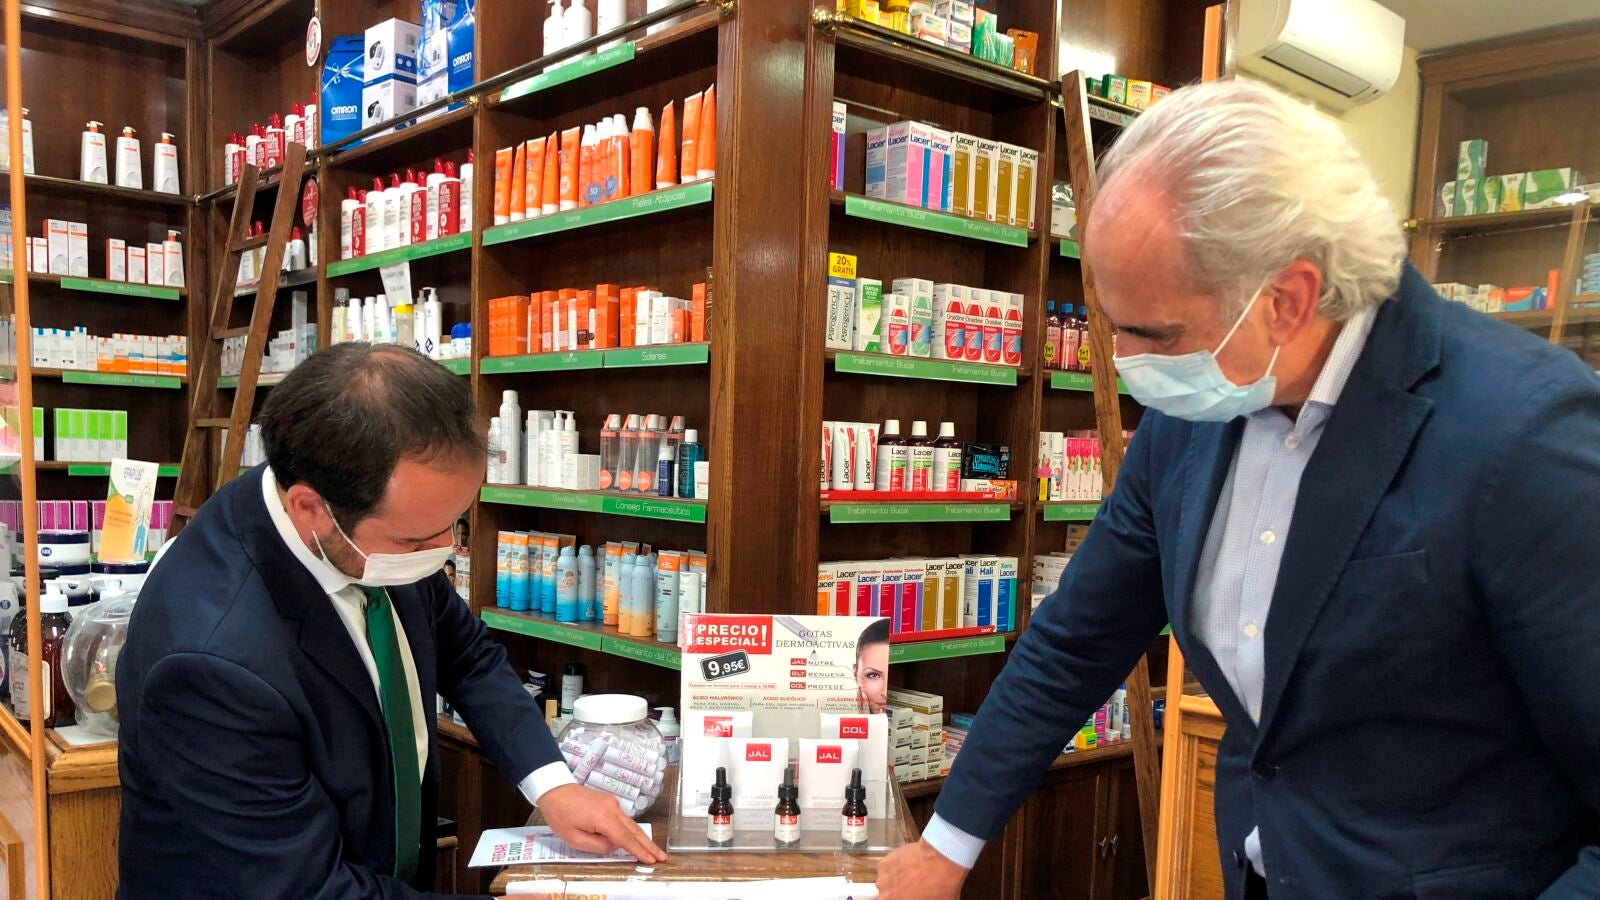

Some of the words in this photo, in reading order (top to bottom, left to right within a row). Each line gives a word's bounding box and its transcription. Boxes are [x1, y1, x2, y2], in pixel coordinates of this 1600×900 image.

[452, 52, 472, 67] OMRON
[331, 105, 357, 114] OMRON
[888, 135, 908, 145] Lacer
[911, 134, 929, 145] Lacer
[956, 135, 975, 146] Lacer
[868, 140, 885, 149] Lacer
[931, 140, 950, 151] Lacer
[977, 140, 994, 151] Lacer
[1000, 145, 1018, 156] Lacer
[1020, 149, 1037, 160] Lacer
[836, 256, 852, 267] 20%
[833, 266, 854, 275] GRATIS
[828, 290, 837, 341] Parogencyl
[913, 308, 931, 317] Oraldine
[841, 292, 850, 343] Parogencyl
[947, 314, 965, 322] Oraldine
[965, 316, 983, 324] Oraldine
[642, 352, 666, 361] Solares
[616, 500, 641, 513] Consejo
[847, 507, 888, 515] Tratamiento
[926, 563, 944, 571] Lacer
[945, 562, 964, 570] Lacer
[836, 570, 857, 578] Lacer
[965, 567, 974, 575] ali
[1000, 569, 1016, 577] Lacer
[882, 574, 902, 582] Lacer
[904, 573, 923, 581] Lacer
[697, 624, 759, 636] PRECIO
[799, 630, 833, 638] GOTAS
[697, 637, 759, 646] ESPECIAL
[775, 640, 855, 648] DERMOACTIVAS
[979, 639, 996, 648] Bucal
[612, 640, 653, 658] Tratamiento
[654, 652, 665, 662] del
[708, 659, 746, 676] 9,95€
[706, 725, 730, 734] JAL
[842, 726, 866, 734] COL
[508, 842, 522, 855] COVID
